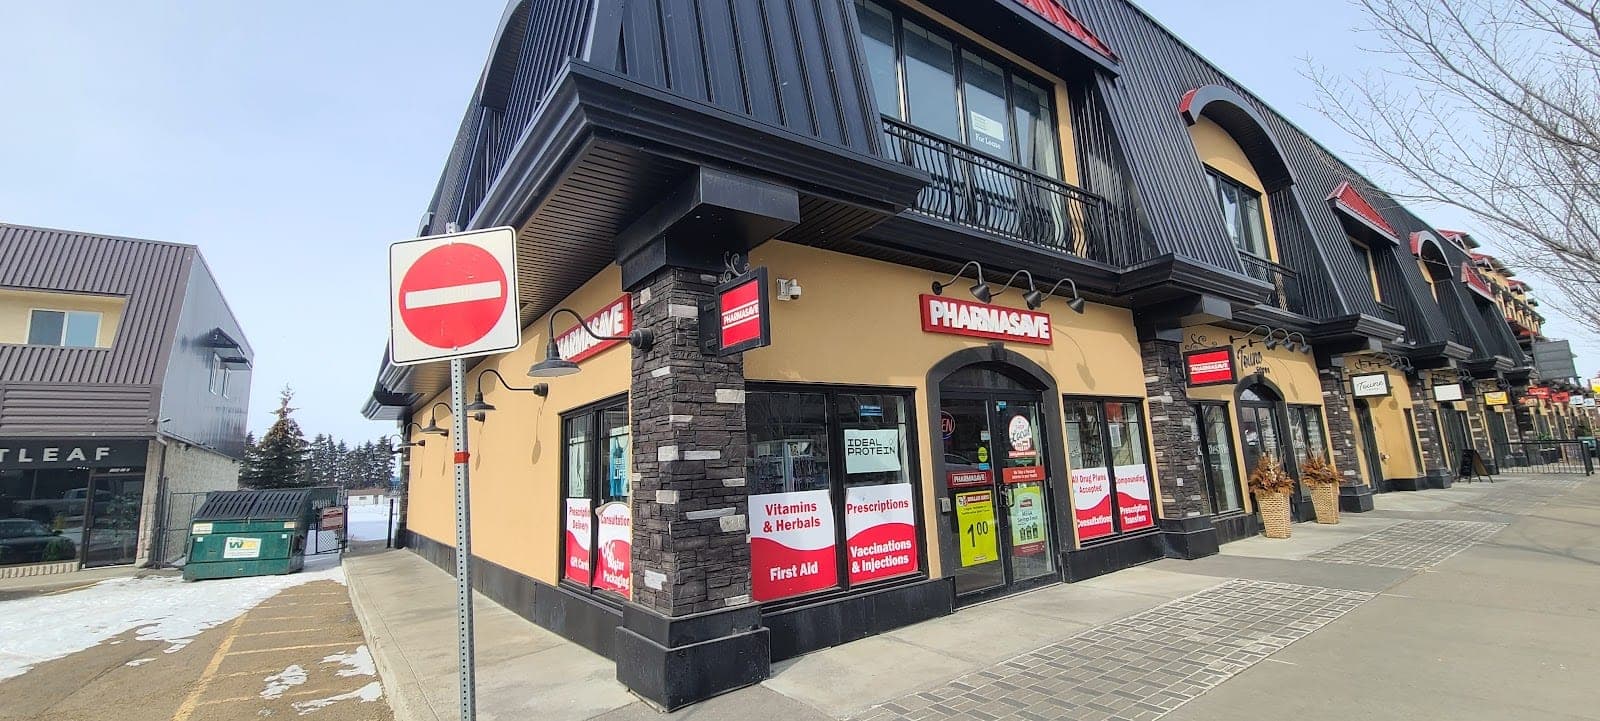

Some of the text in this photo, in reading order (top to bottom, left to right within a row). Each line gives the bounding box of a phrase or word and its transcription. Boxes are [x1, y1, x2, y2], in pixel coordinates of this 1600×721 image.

[975, 132, 1001, 149] For Lease
[723, 303, 759, 325] PHARMASAVE
[929, 299, 1050, 339] PHARMASAVE
[847, 438, 883, 447] IDEAL
[847, 447, 896, 456] PROTEIN
[765, 501, 817, 516] Vitamins
[846, 499, 909, 515] Prescriptions
[763, 516, 821, 533] & Herbals
[850, 539, 912, 558] Vaccinations
[770, 561, 819, 582] First Aid
[851, 554, 909, 573] & Injections
